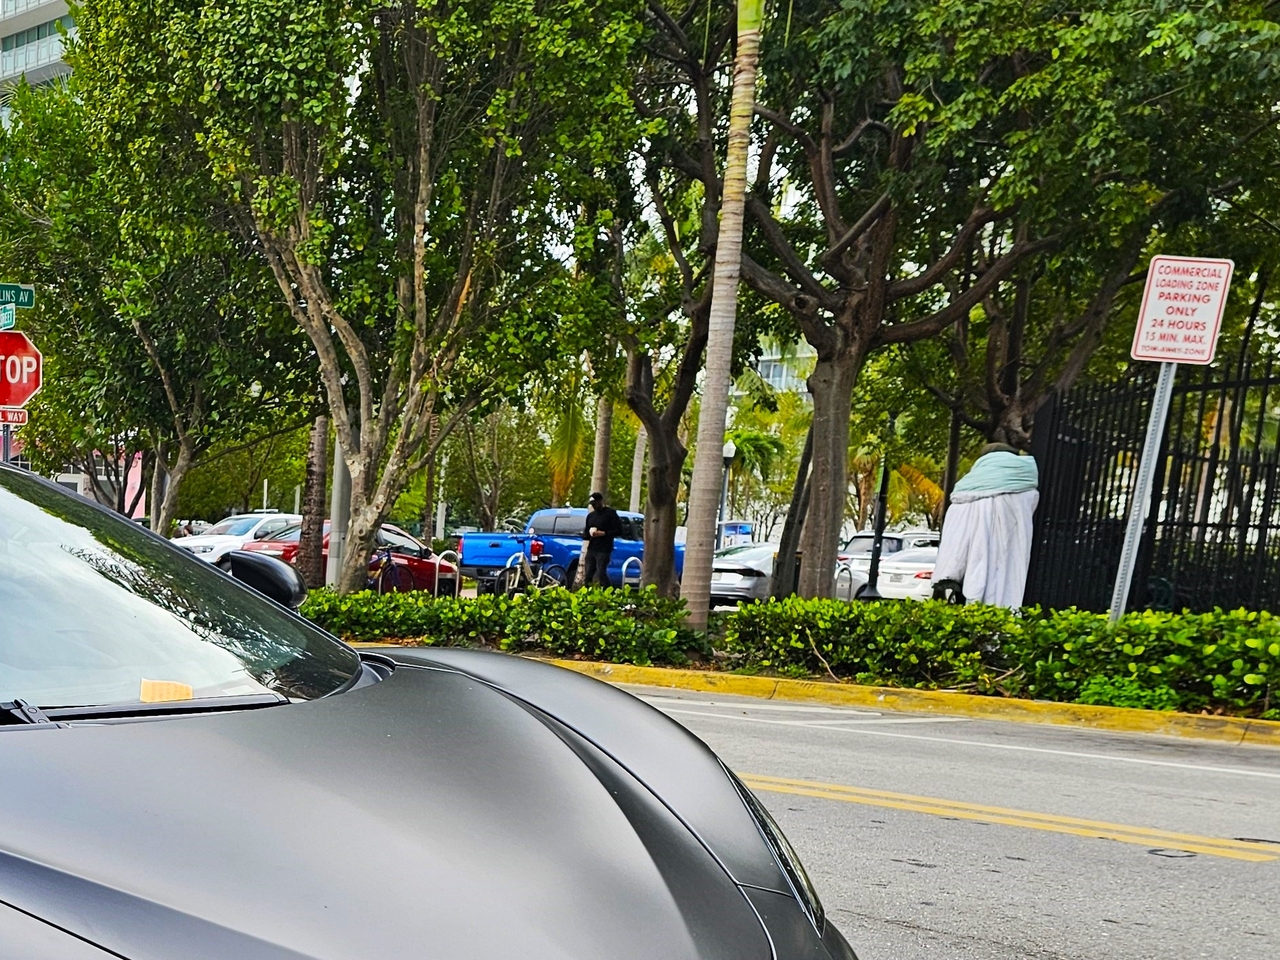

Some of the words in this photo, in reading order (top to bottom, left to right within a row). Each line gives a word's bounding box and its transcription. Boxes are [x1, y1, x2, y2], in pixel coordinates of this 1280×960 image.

[1158, 265, 1222, 278] COMMERCIAL
[1156, 279, 1193, 290] LOADING
[1196, 281, 1219, 291] ZONE
[19, 291, 29, 302] AV
[1158, 292, 1211, 303] PARKING
[1166, 306, 1198, 316] ONLY
[1151, 319, 1164, 328] 24
[1168, 320, 1206, 331] HOURS
[1146, 332, 1156, 341] 15
[1158, 333, 1179, 343] MIN.
[1182, 335, 1206, 344] MAX.
[7, 412, 23, 422] WAY
